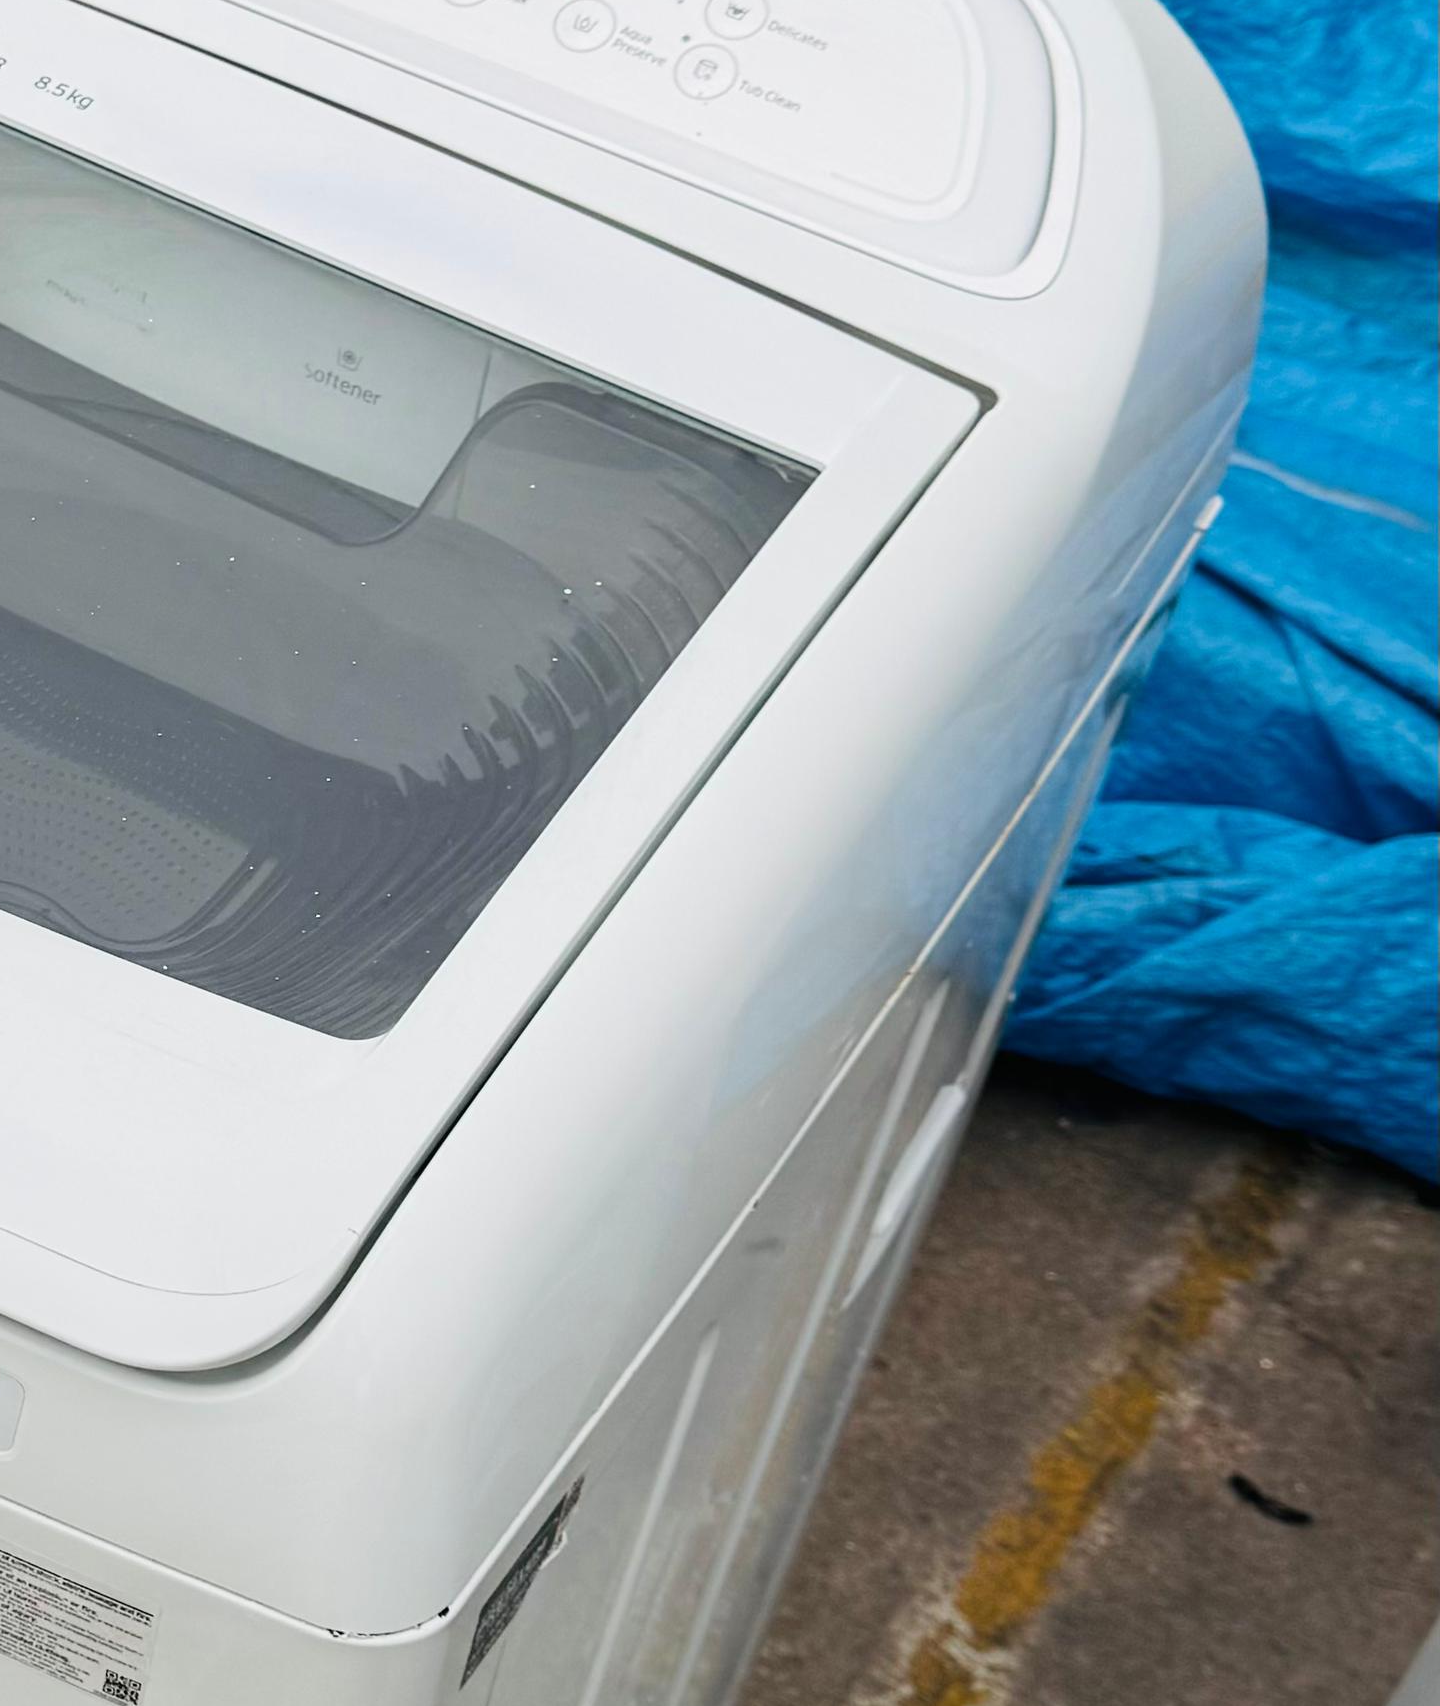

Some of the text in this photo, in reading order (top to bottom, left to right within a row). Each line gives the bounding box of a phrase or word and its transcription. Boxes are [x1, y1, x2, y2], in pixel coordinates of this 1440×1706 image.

[620, 26, 654, 47] Aqua
[768, 19, 830, 52] Delicates
[612, 38, 668, 68] Preserve
[739, 79, 802, 114] Tub Clean
[304, 362, 382, 407] Softener
